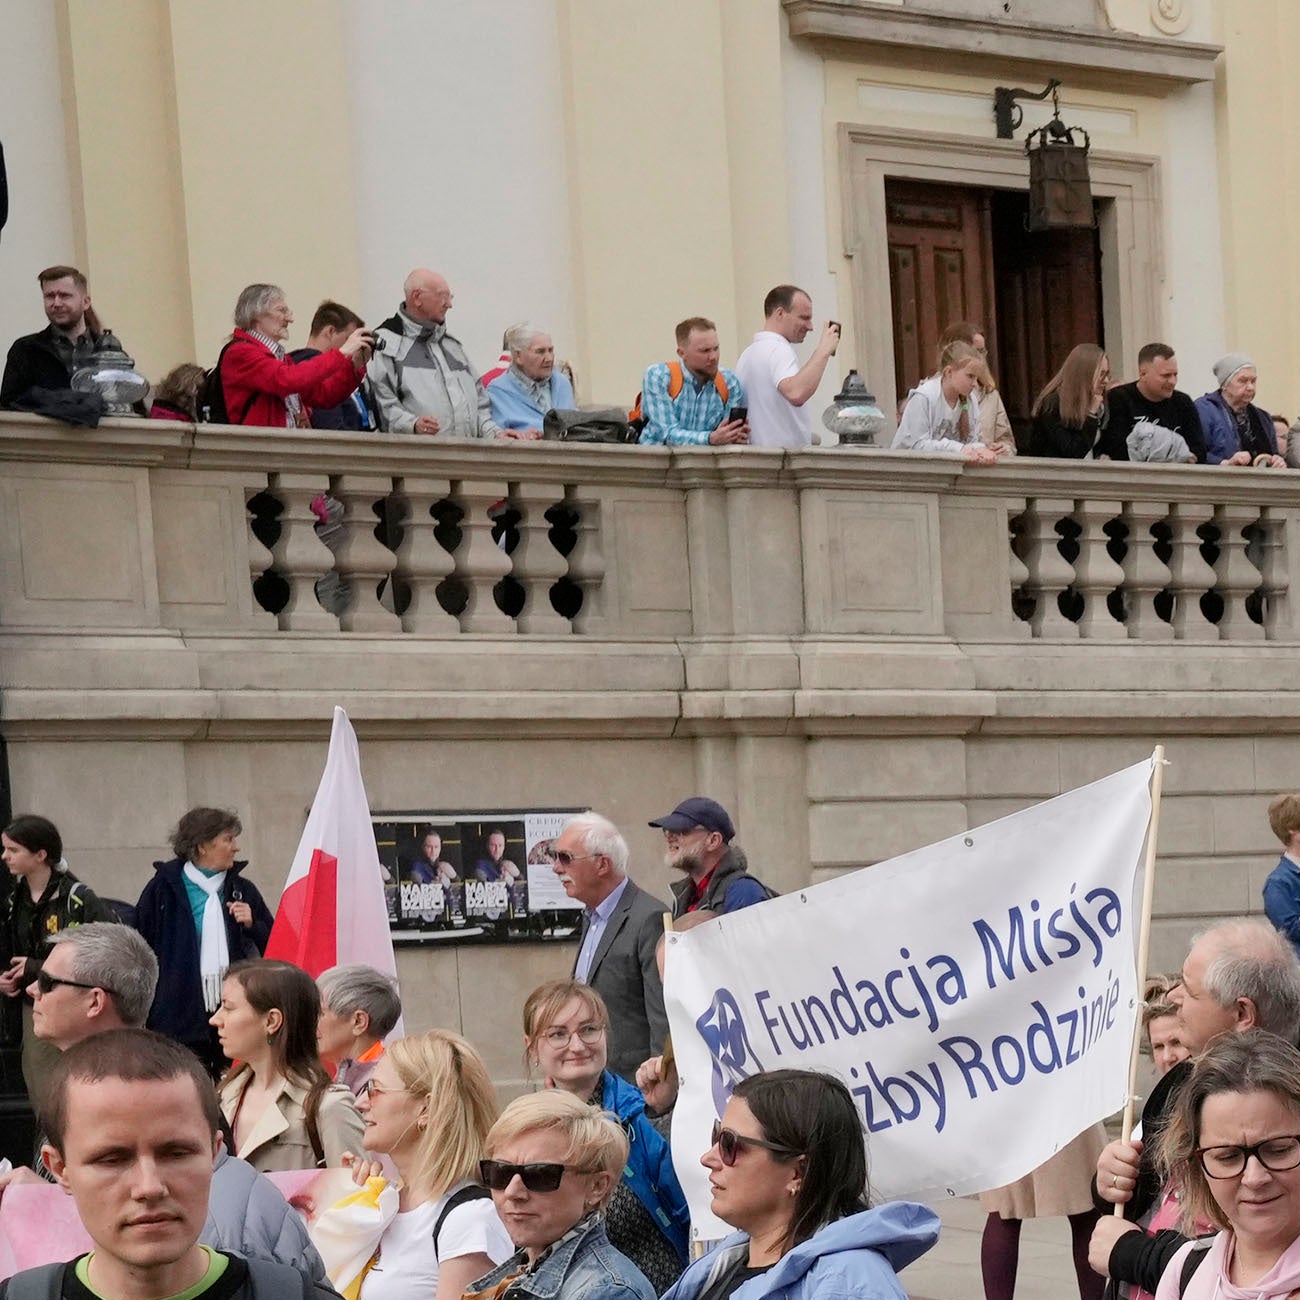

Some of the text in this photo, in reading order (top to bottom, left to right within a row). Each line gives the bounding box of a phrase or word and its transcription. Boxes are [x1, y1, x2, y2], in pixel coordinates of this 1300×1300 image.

[755, 882, 1122, 1056] Fundacja Misja
[938, 968, 1120, 1100] Rodzinie
